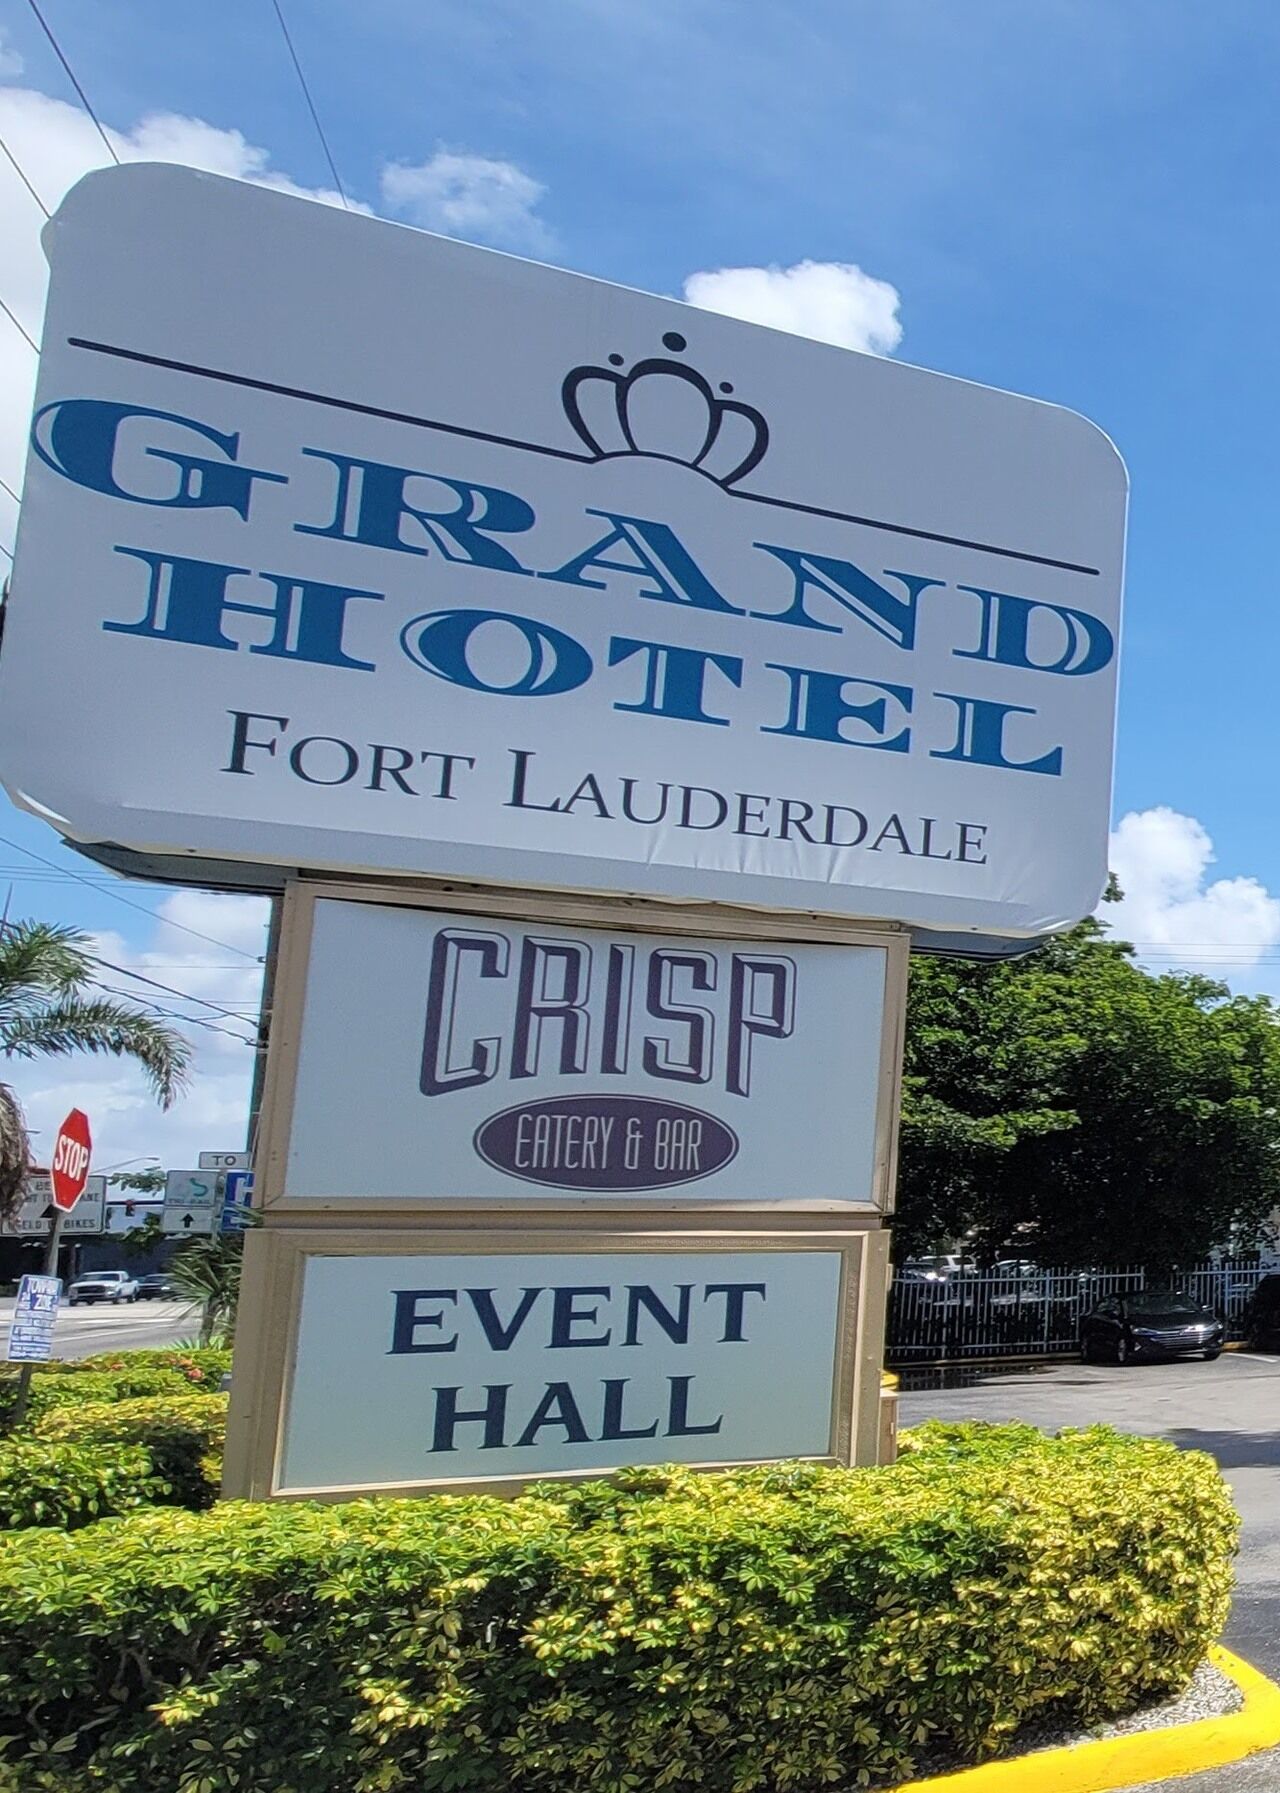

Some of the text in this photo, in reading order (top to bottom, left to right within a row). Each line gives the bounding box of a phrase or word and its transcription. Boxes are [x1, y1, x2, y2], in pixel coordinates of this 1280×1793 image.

[30, 398, 1115, 676] GRAND
[102, 544, 1063, 777] HOTEL
[220, 709, 989, 866] FORT LAUDERDALE
[418, 926, 799, 1099] CRISP
[54, 1134, 89, 1181] STOP
[212, 1155, 237, 1167] TO
[514, 1113, 702, 1171] EATERY & BAR
[63, 1218, 96, 1229] BIKES
[386, 1282, 766, 1355] EVENT
[426, 1375, 724, 1453] HALL
